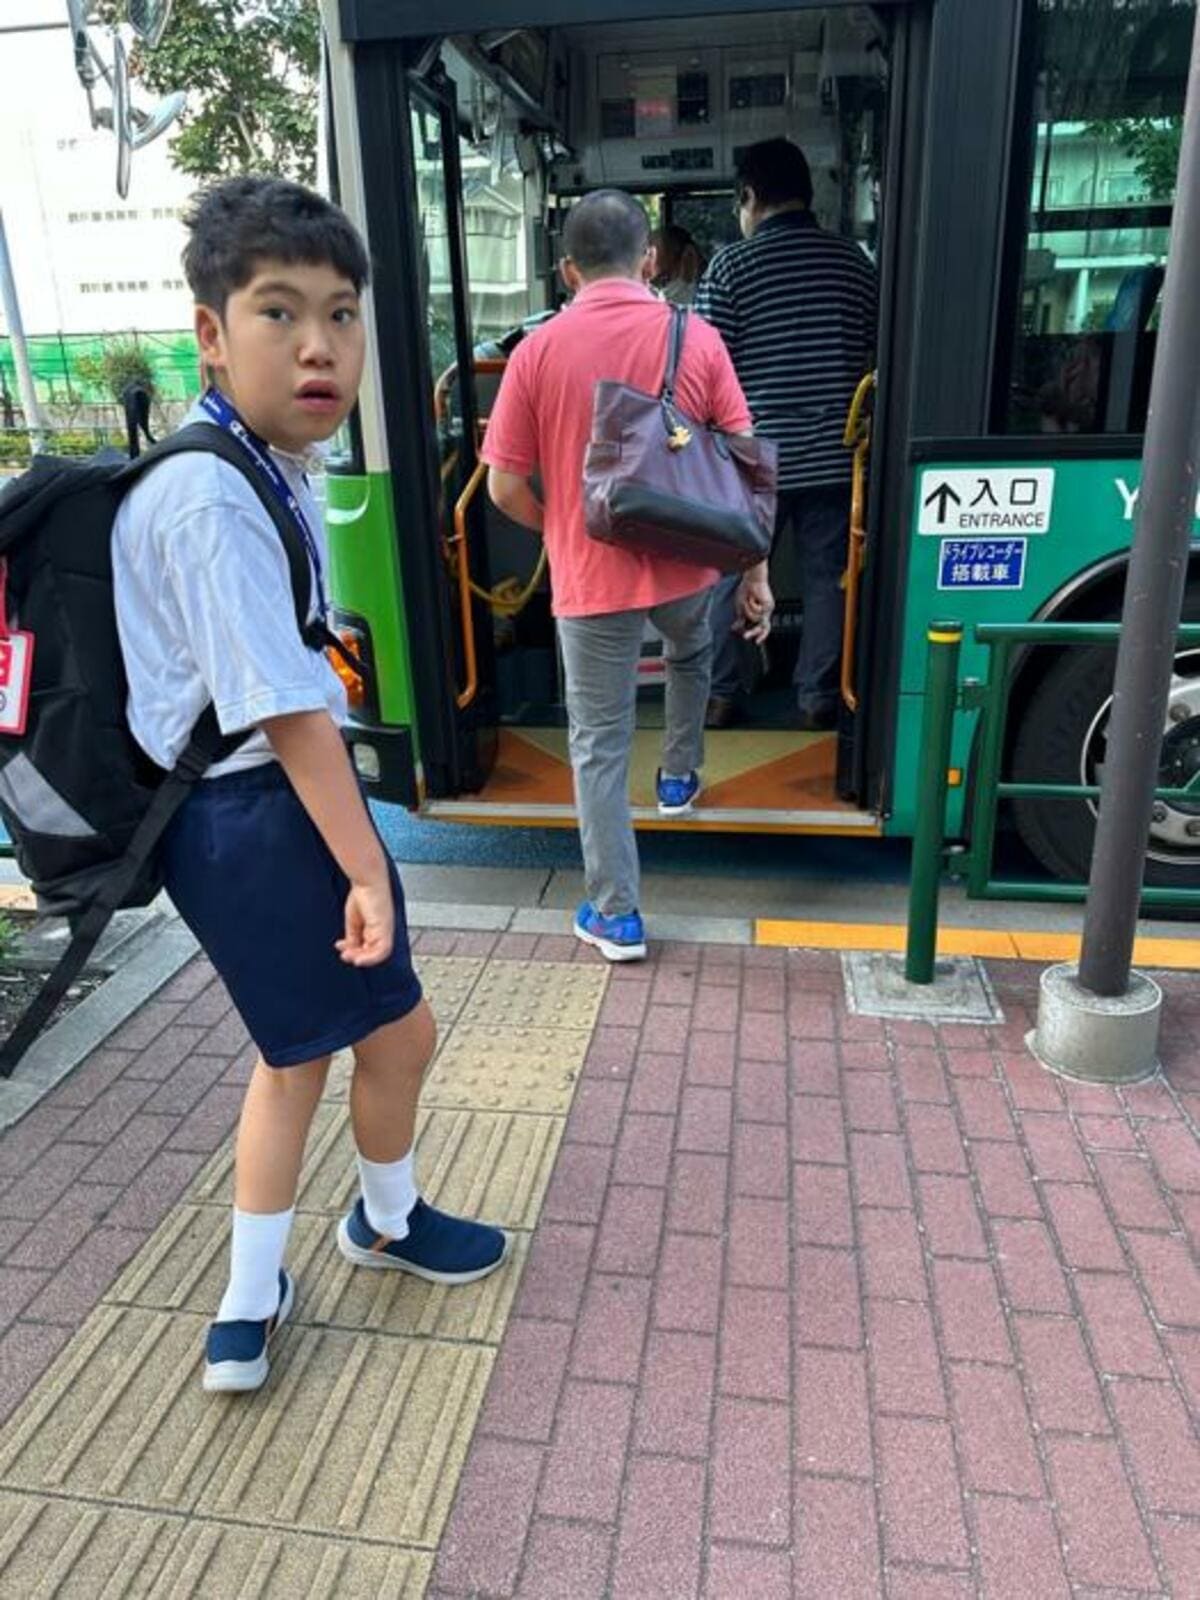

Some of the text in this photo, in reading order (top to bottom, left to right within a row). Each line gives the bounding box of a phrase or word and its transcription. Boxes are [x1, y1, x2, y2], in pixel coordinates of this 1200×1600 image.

[969, 478, 1039, 507] 入口
[959, 512, 1045, 528] ENTRANCE
[950, 563, 1010, 582] 搭載車
